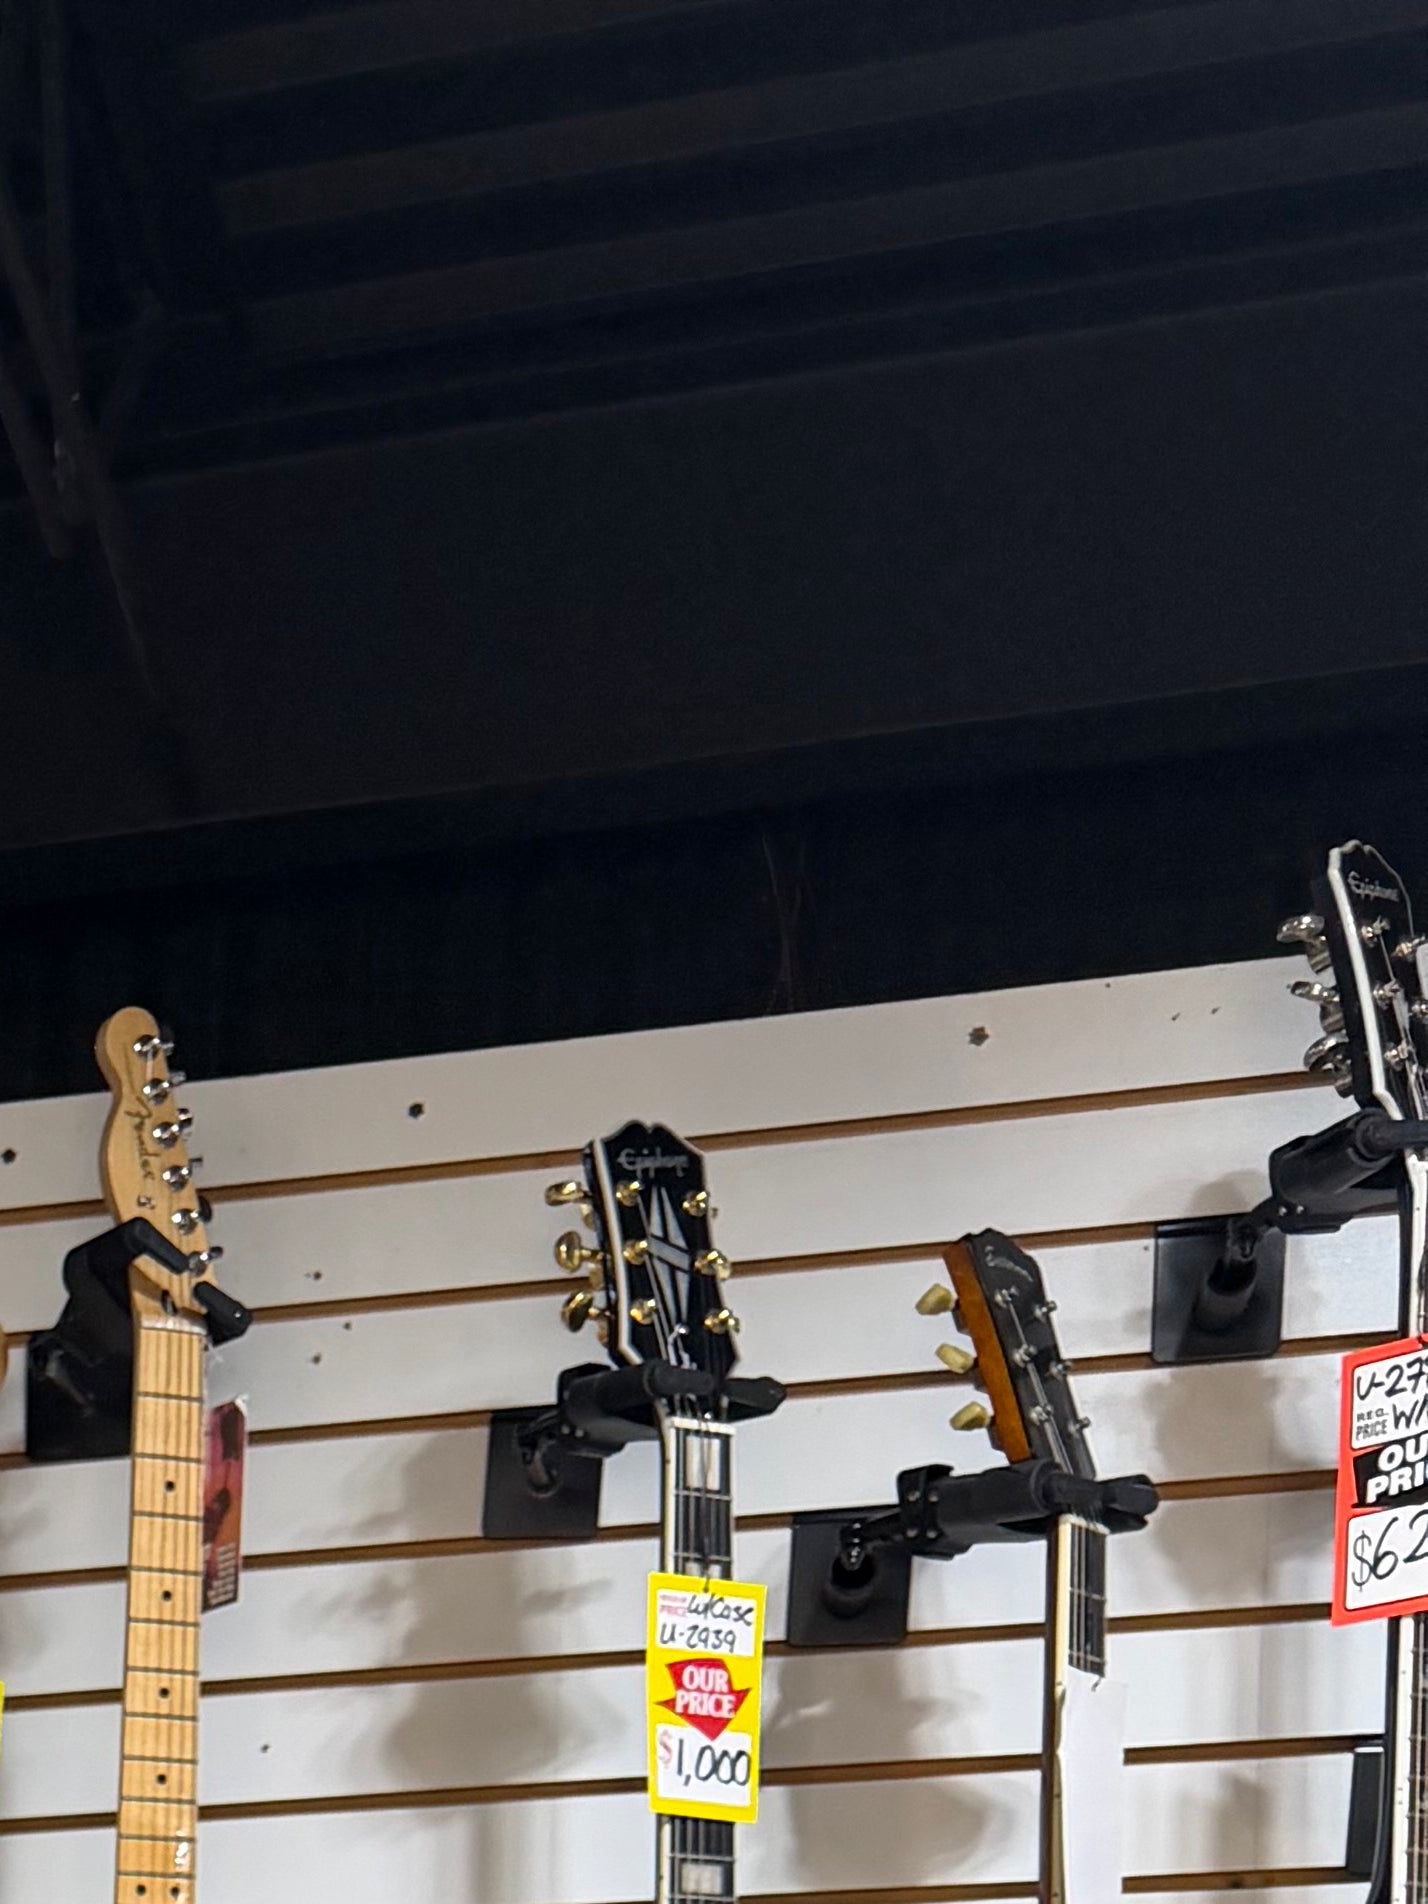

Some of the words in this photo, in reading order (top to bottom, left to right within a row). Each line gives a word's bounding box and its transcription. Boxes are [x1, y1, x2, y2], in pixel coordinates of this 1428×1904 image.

[617, 1146, 689, 1178] Epiphone
[1357, 1356, 1428, 1401] U-27
[1356, 1420, 1387, 1440] PRICE
[660, 1623, 736, 1653] U-2939
[682, 1666, 729, 1692] OUR
[675, 1690, 736, 1718] PRICE
[658, 1730, 752, 1786] $1,000
